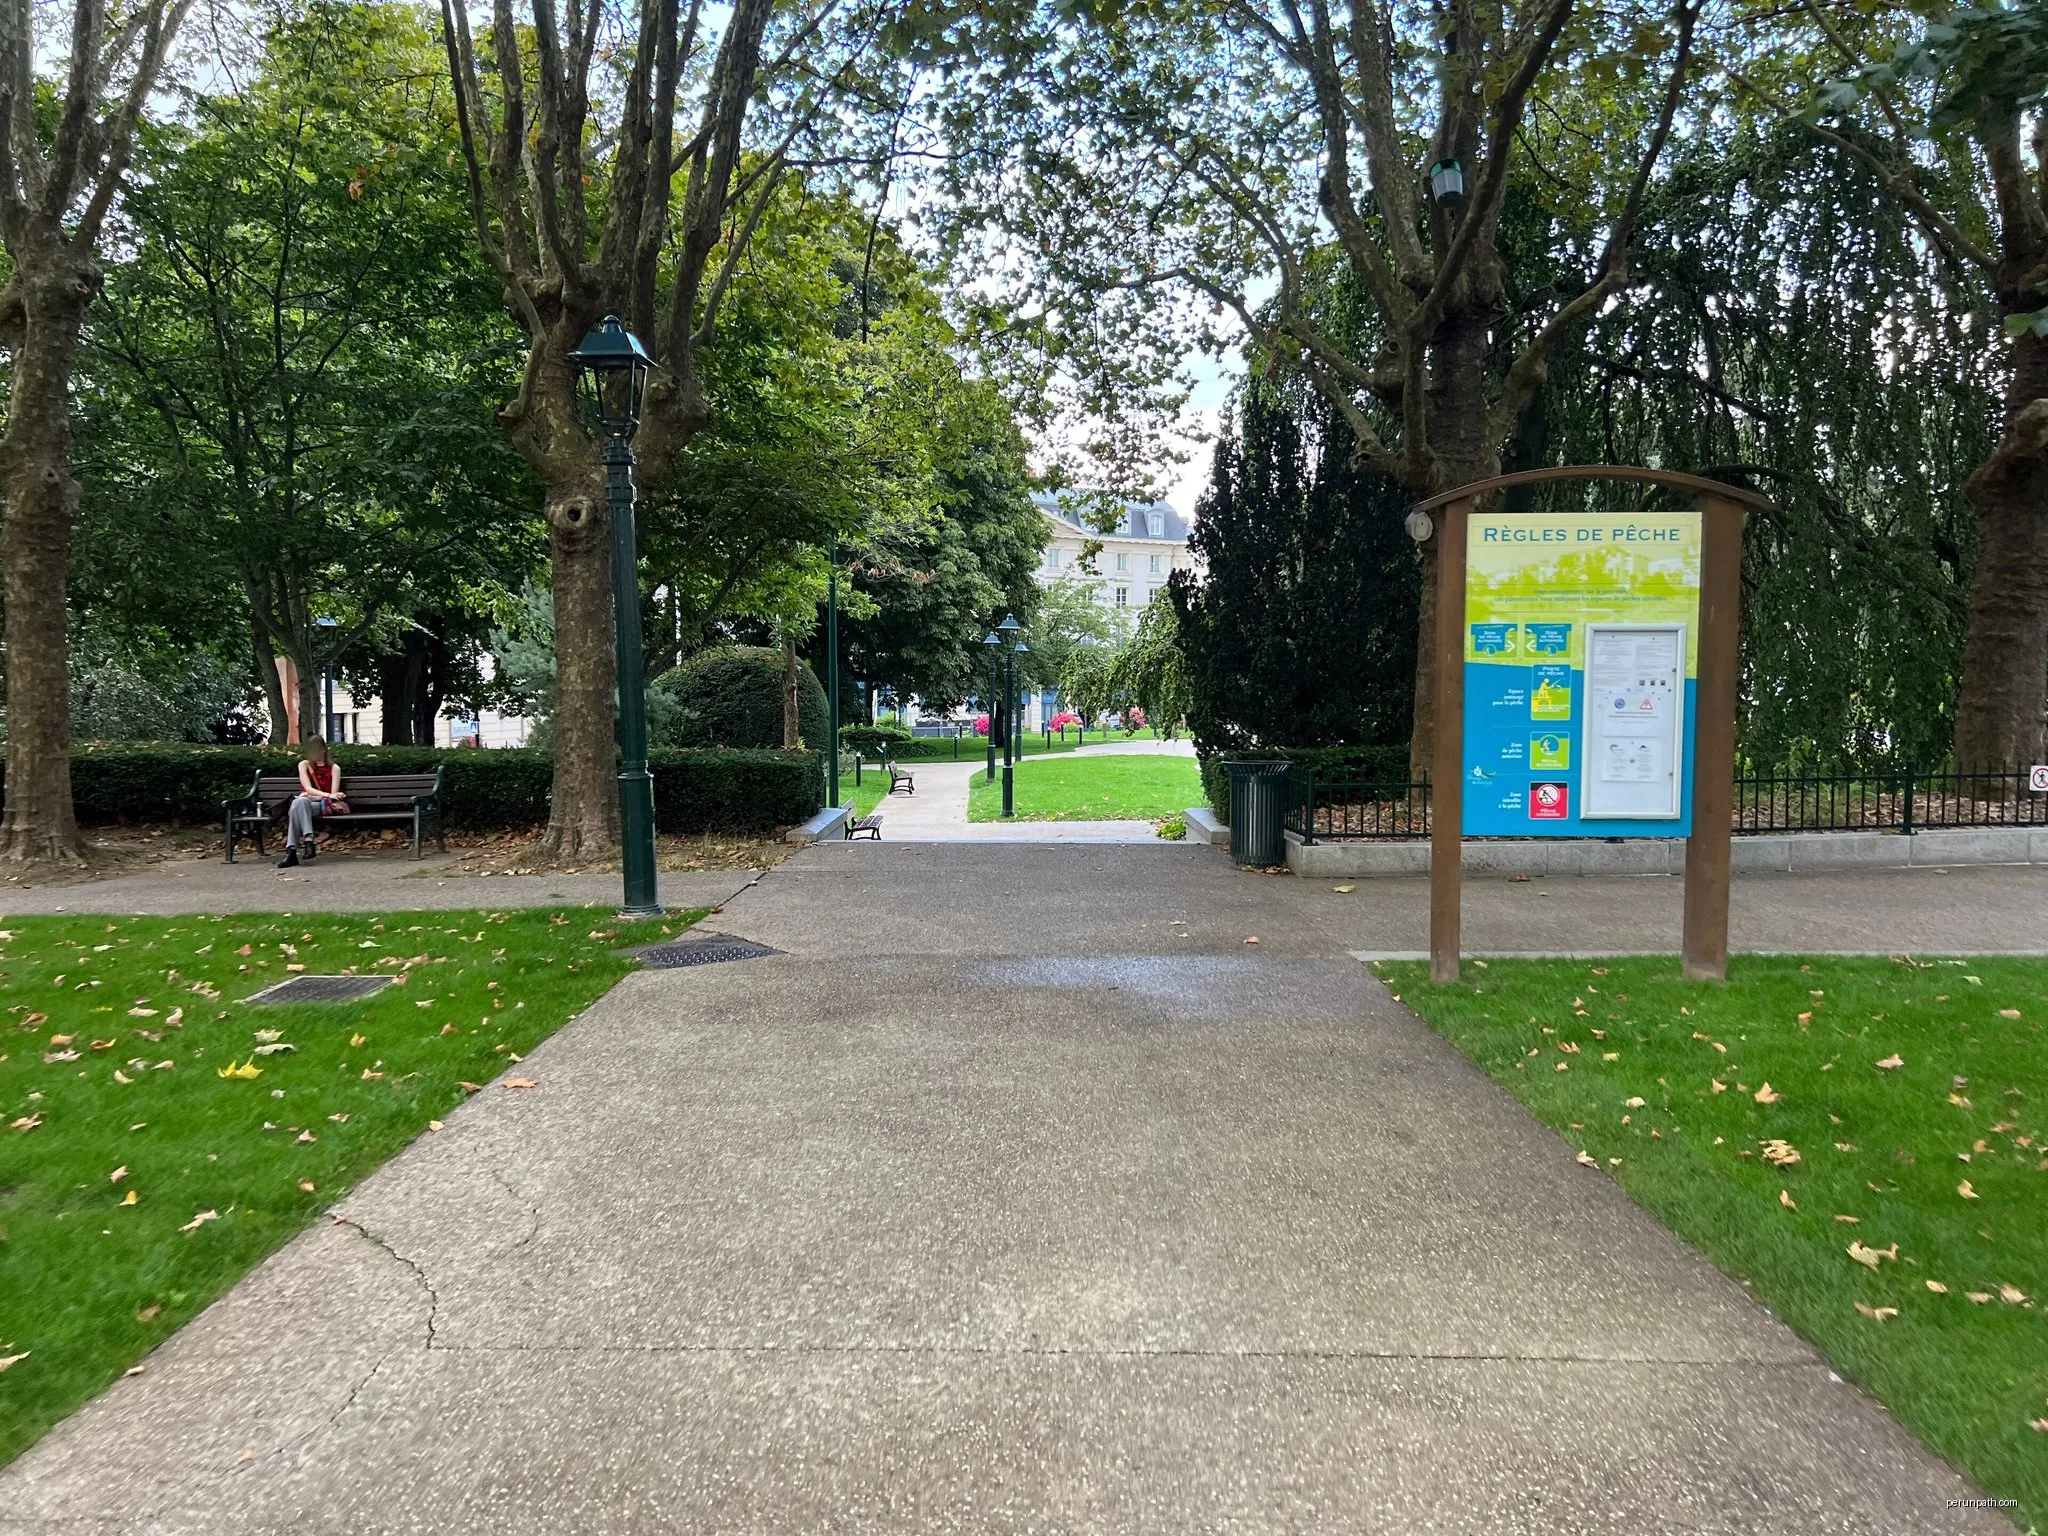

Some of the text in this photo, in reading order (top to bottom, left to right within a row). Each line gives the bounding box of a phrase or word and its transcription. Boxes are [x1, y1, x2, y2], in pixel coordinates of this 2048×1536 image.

[1483, 524, 1680, 542] RÈGLES DE PÊCHE
